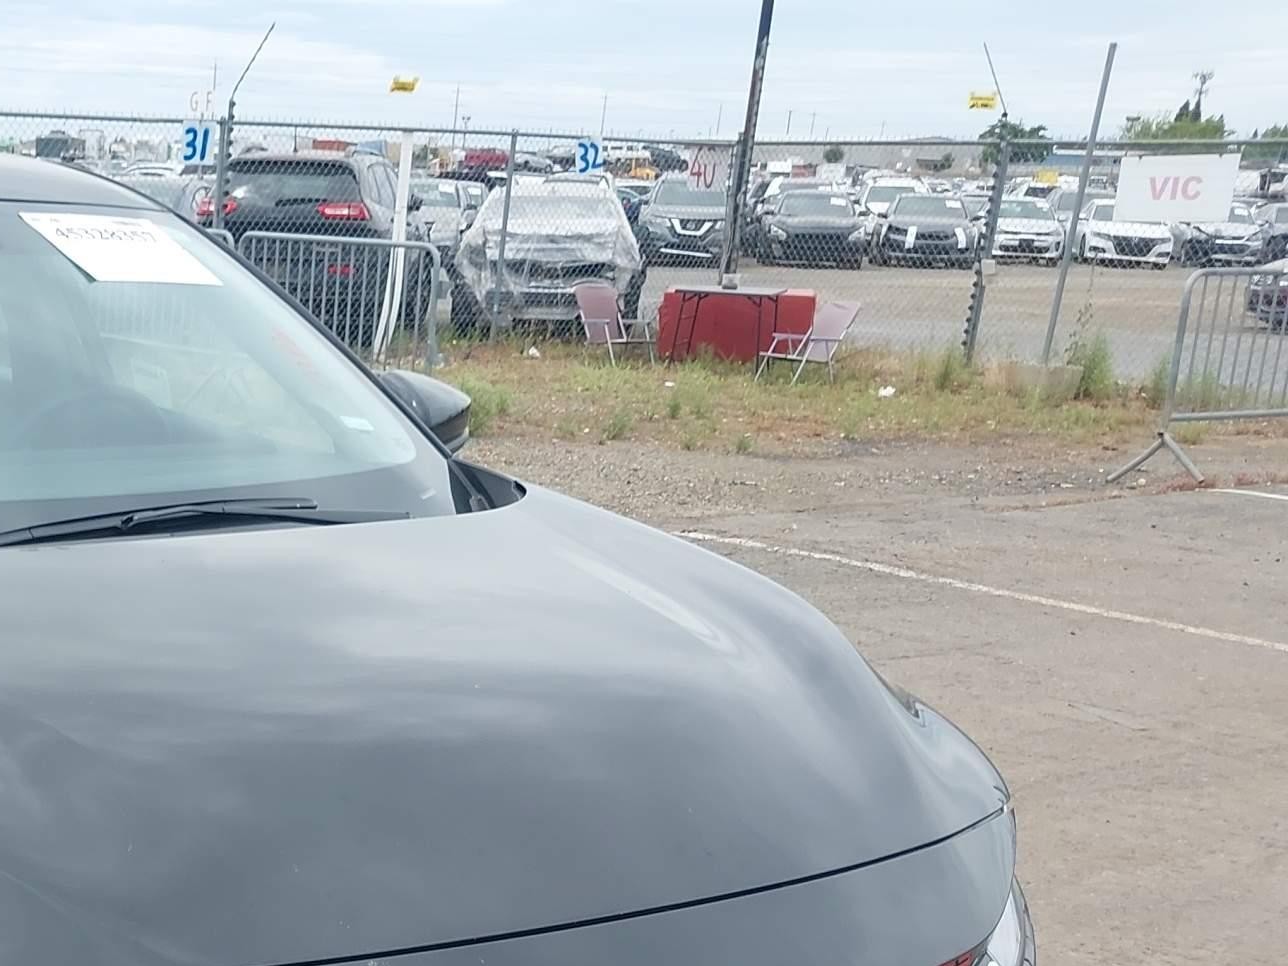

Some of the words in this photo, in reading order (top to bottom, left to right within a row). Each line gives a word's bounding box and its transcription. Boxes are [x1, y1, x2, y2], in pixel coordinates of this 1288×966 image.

[183, 127, 210, 161] 31
[578, 142, 607, 173] 32
[1149, 175, 1203, 201] VIC
